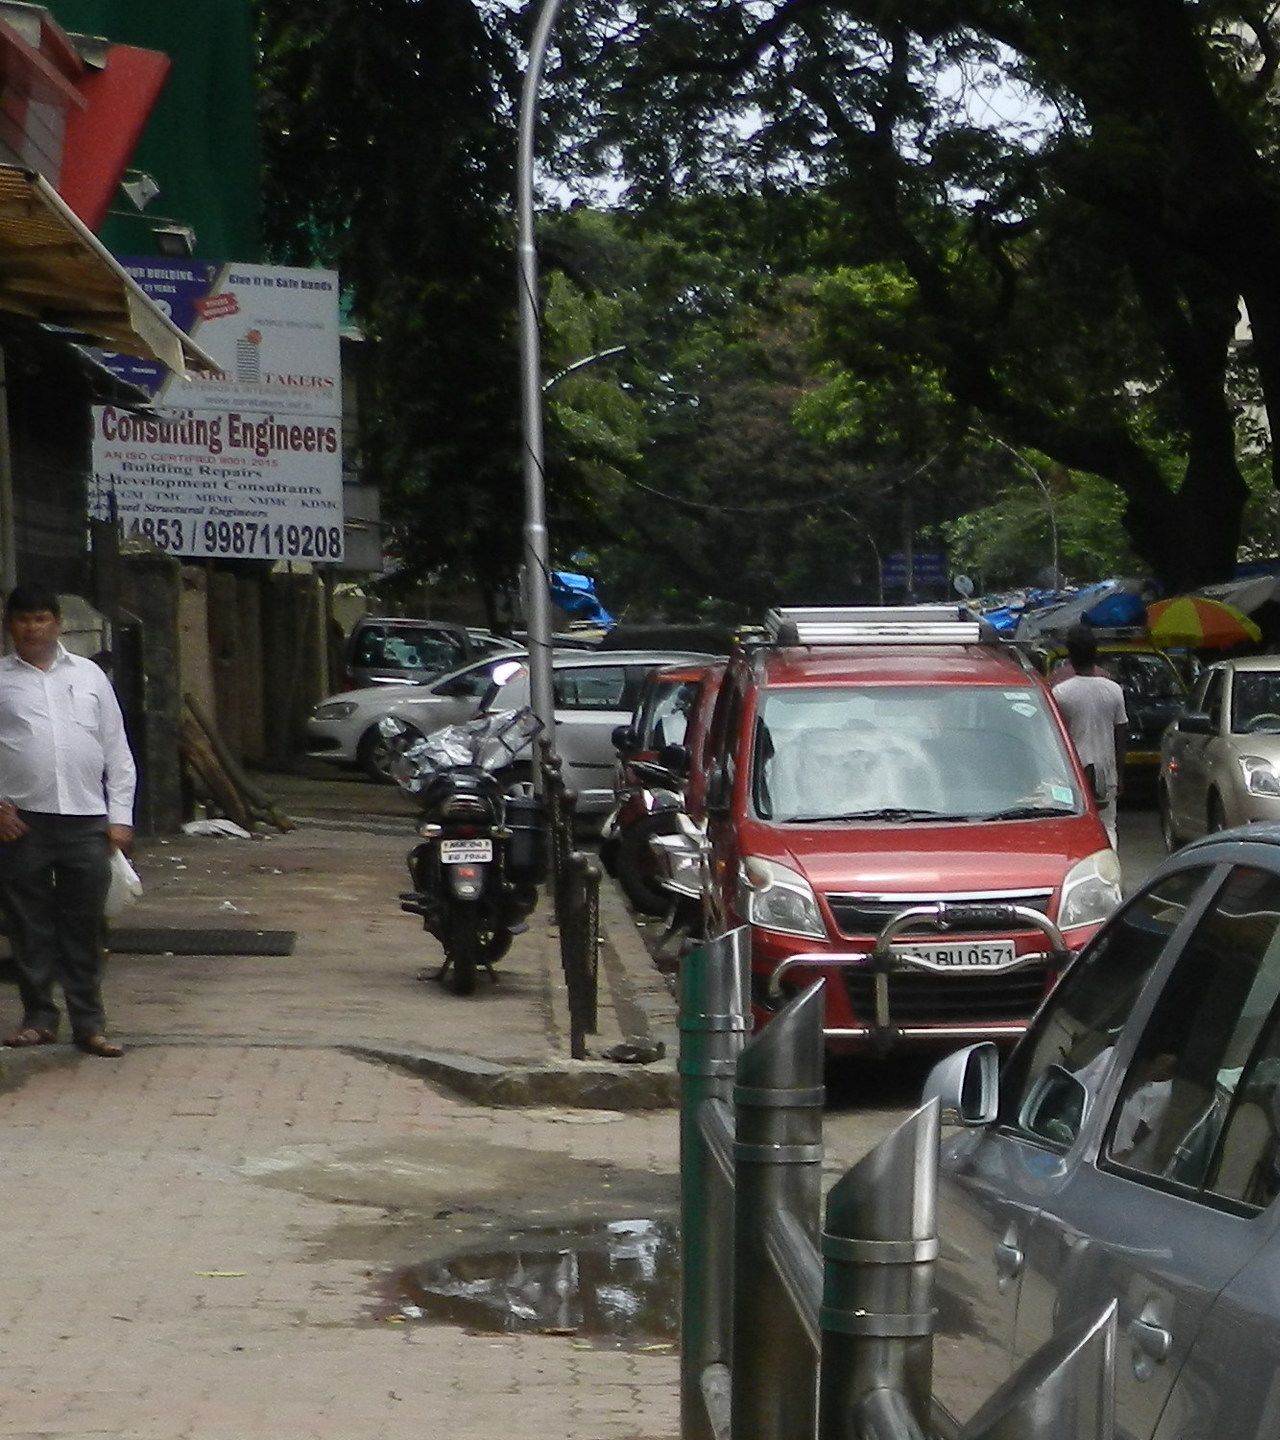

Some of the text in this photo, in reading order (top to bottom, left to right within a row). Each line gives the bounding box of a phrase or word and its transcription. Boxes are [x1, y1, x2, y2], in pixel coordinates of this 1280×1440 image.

[265, 372, 335, 389] TAKERS
[102, 406, 338, 458] Consulting Engineers
[122, 462, 262, 480] Building Repairs
[204, 519, 342, 559] 9987119208
